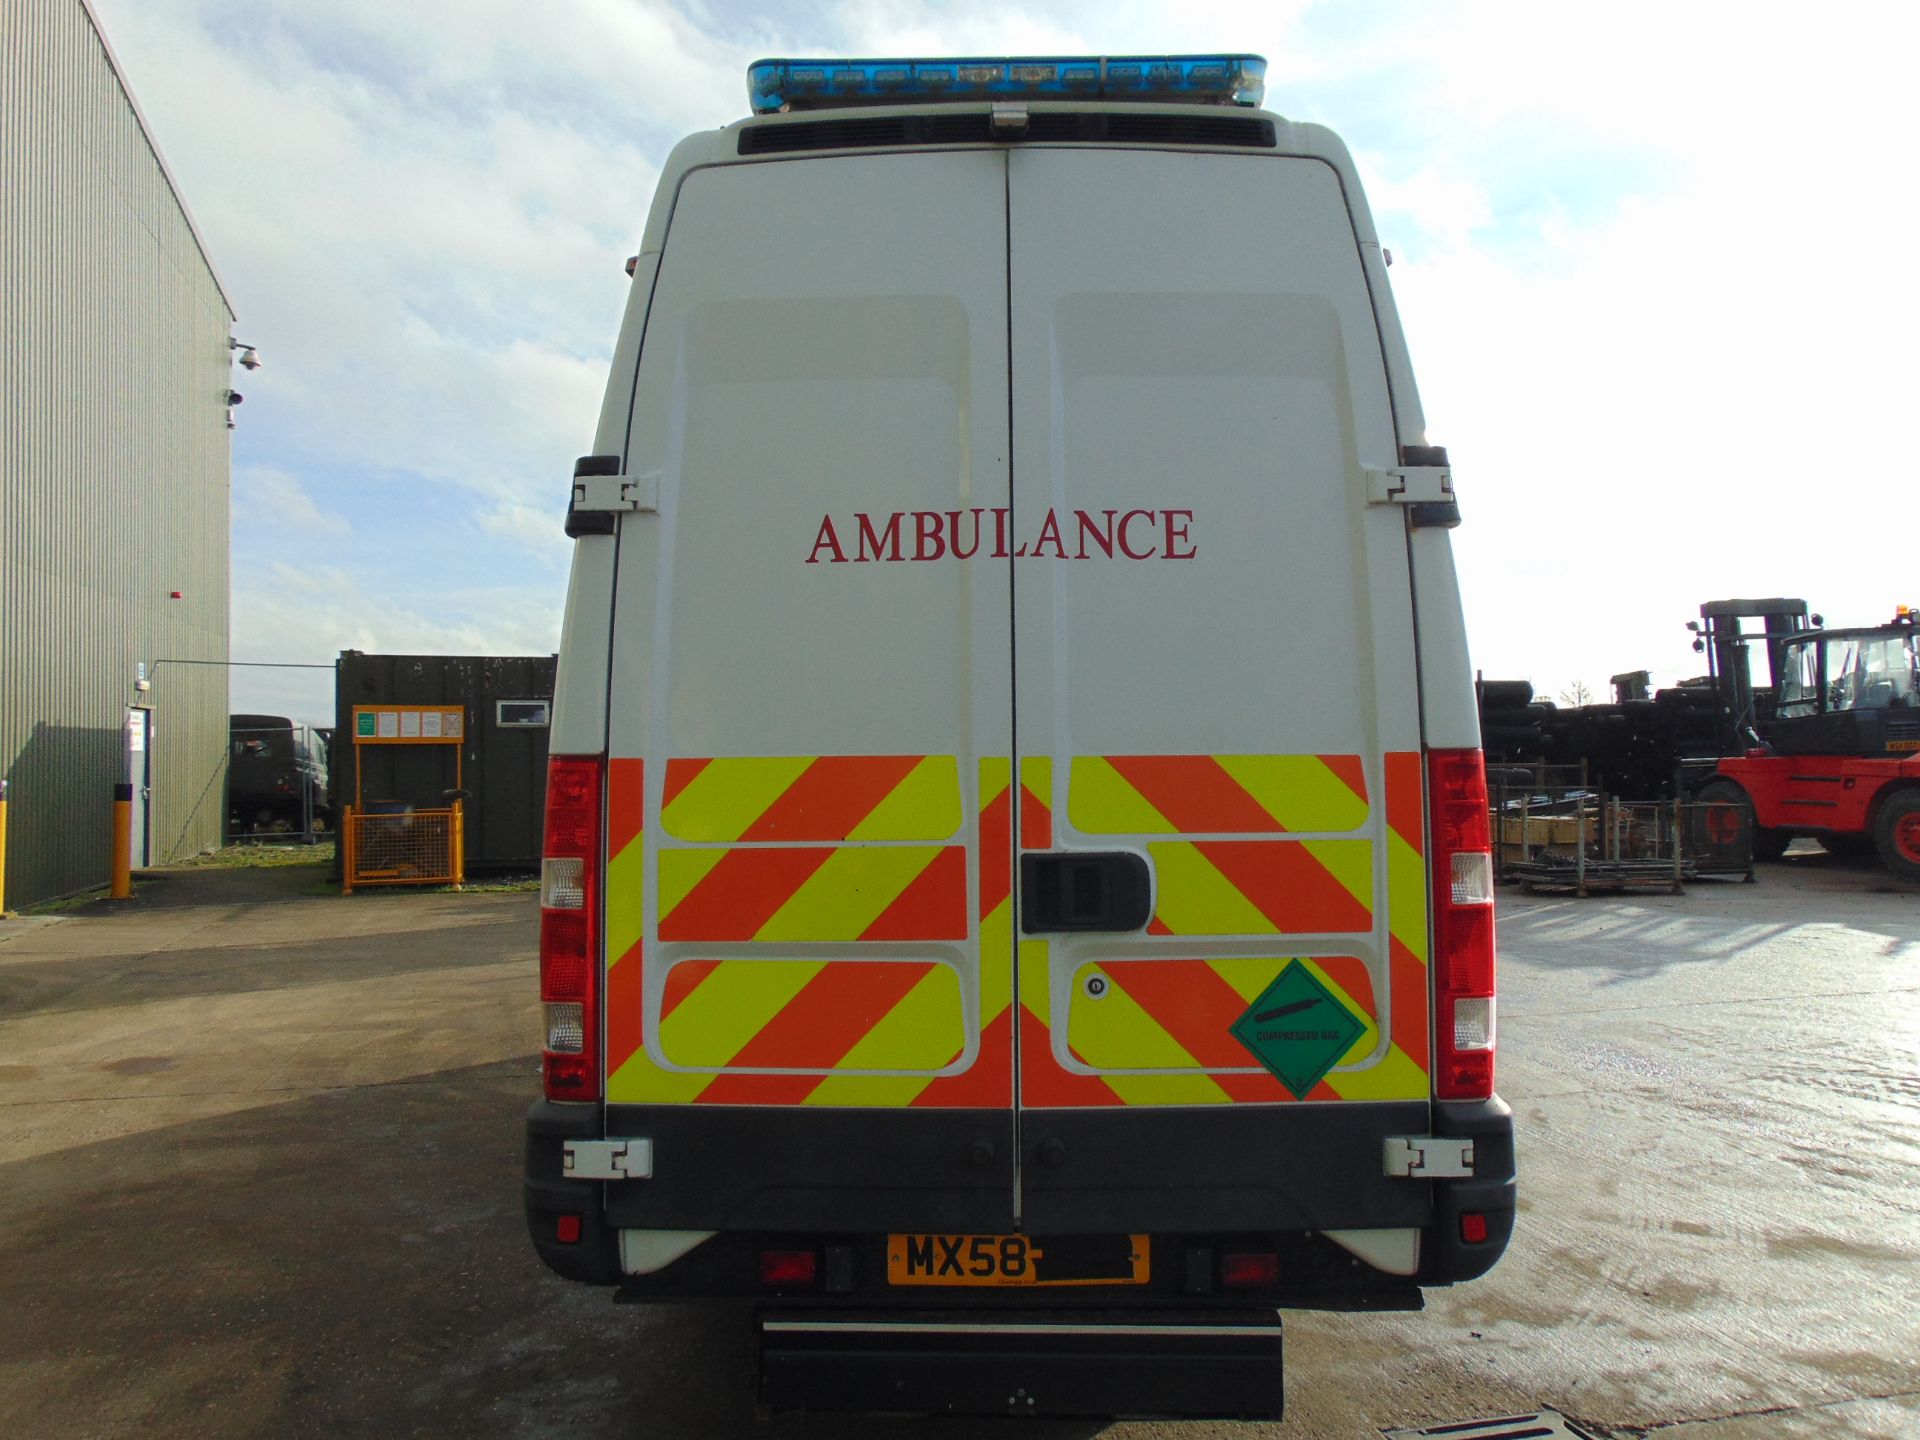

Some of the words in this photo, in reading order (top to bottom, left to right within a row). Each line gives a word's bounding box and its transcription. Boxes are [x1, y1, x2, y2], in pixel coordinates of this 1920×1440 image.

[805, 507, 1198, 563] AMBULANCE
[1256, 1031, 1319, 1041] COMPRESSED
[1321, 1030, 1340, 1040] GAS
[906, 1236, 1026, 1277] MX58
